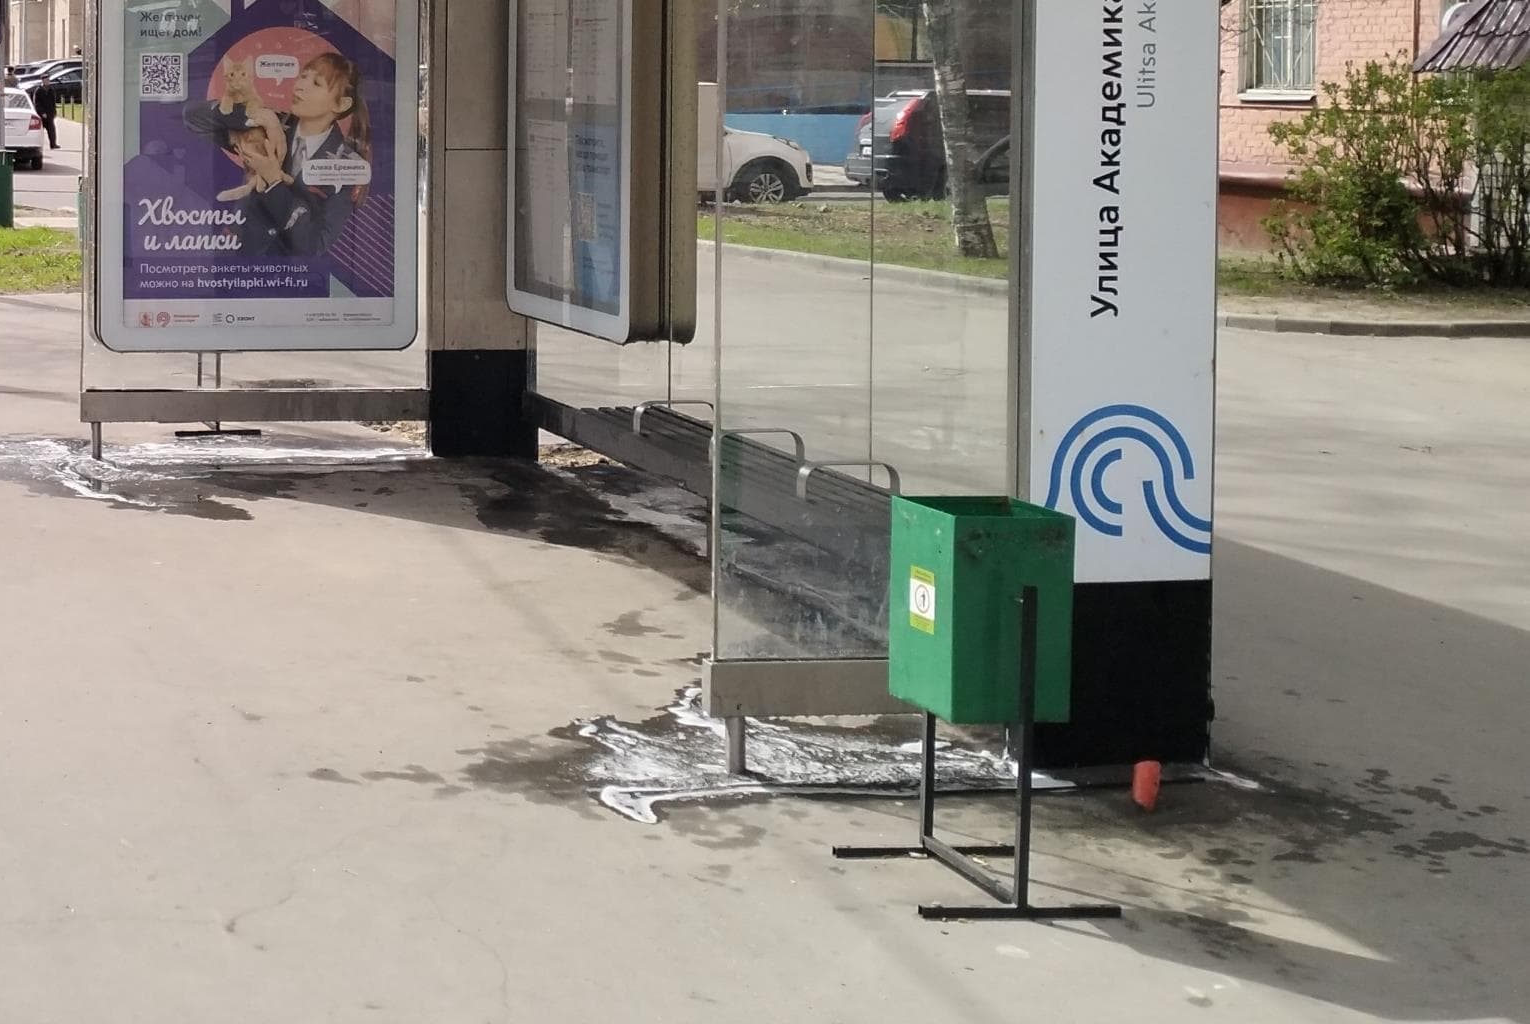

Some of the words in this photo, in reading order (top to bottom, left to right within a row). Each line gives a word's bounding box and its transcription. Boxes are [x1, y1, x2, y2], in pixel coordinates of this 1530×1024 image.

[173, 26, 202, 38] дом!
[1136, 43, 1156, 107] Ulitsa
[138, 196, 246, 226] Хвосты
[144, 234, 161, 250] и
[164, 233, 242, 250] лапки
[140, 263, 208, 275] Посмотреть
[211, 265, 250, 273] анкеты
[253, 264, 308, 273] животных
[1090, 206, 1123, 317] Улица
[140, 280, 179, 288] можно
[181, 279, 194, 287] на
